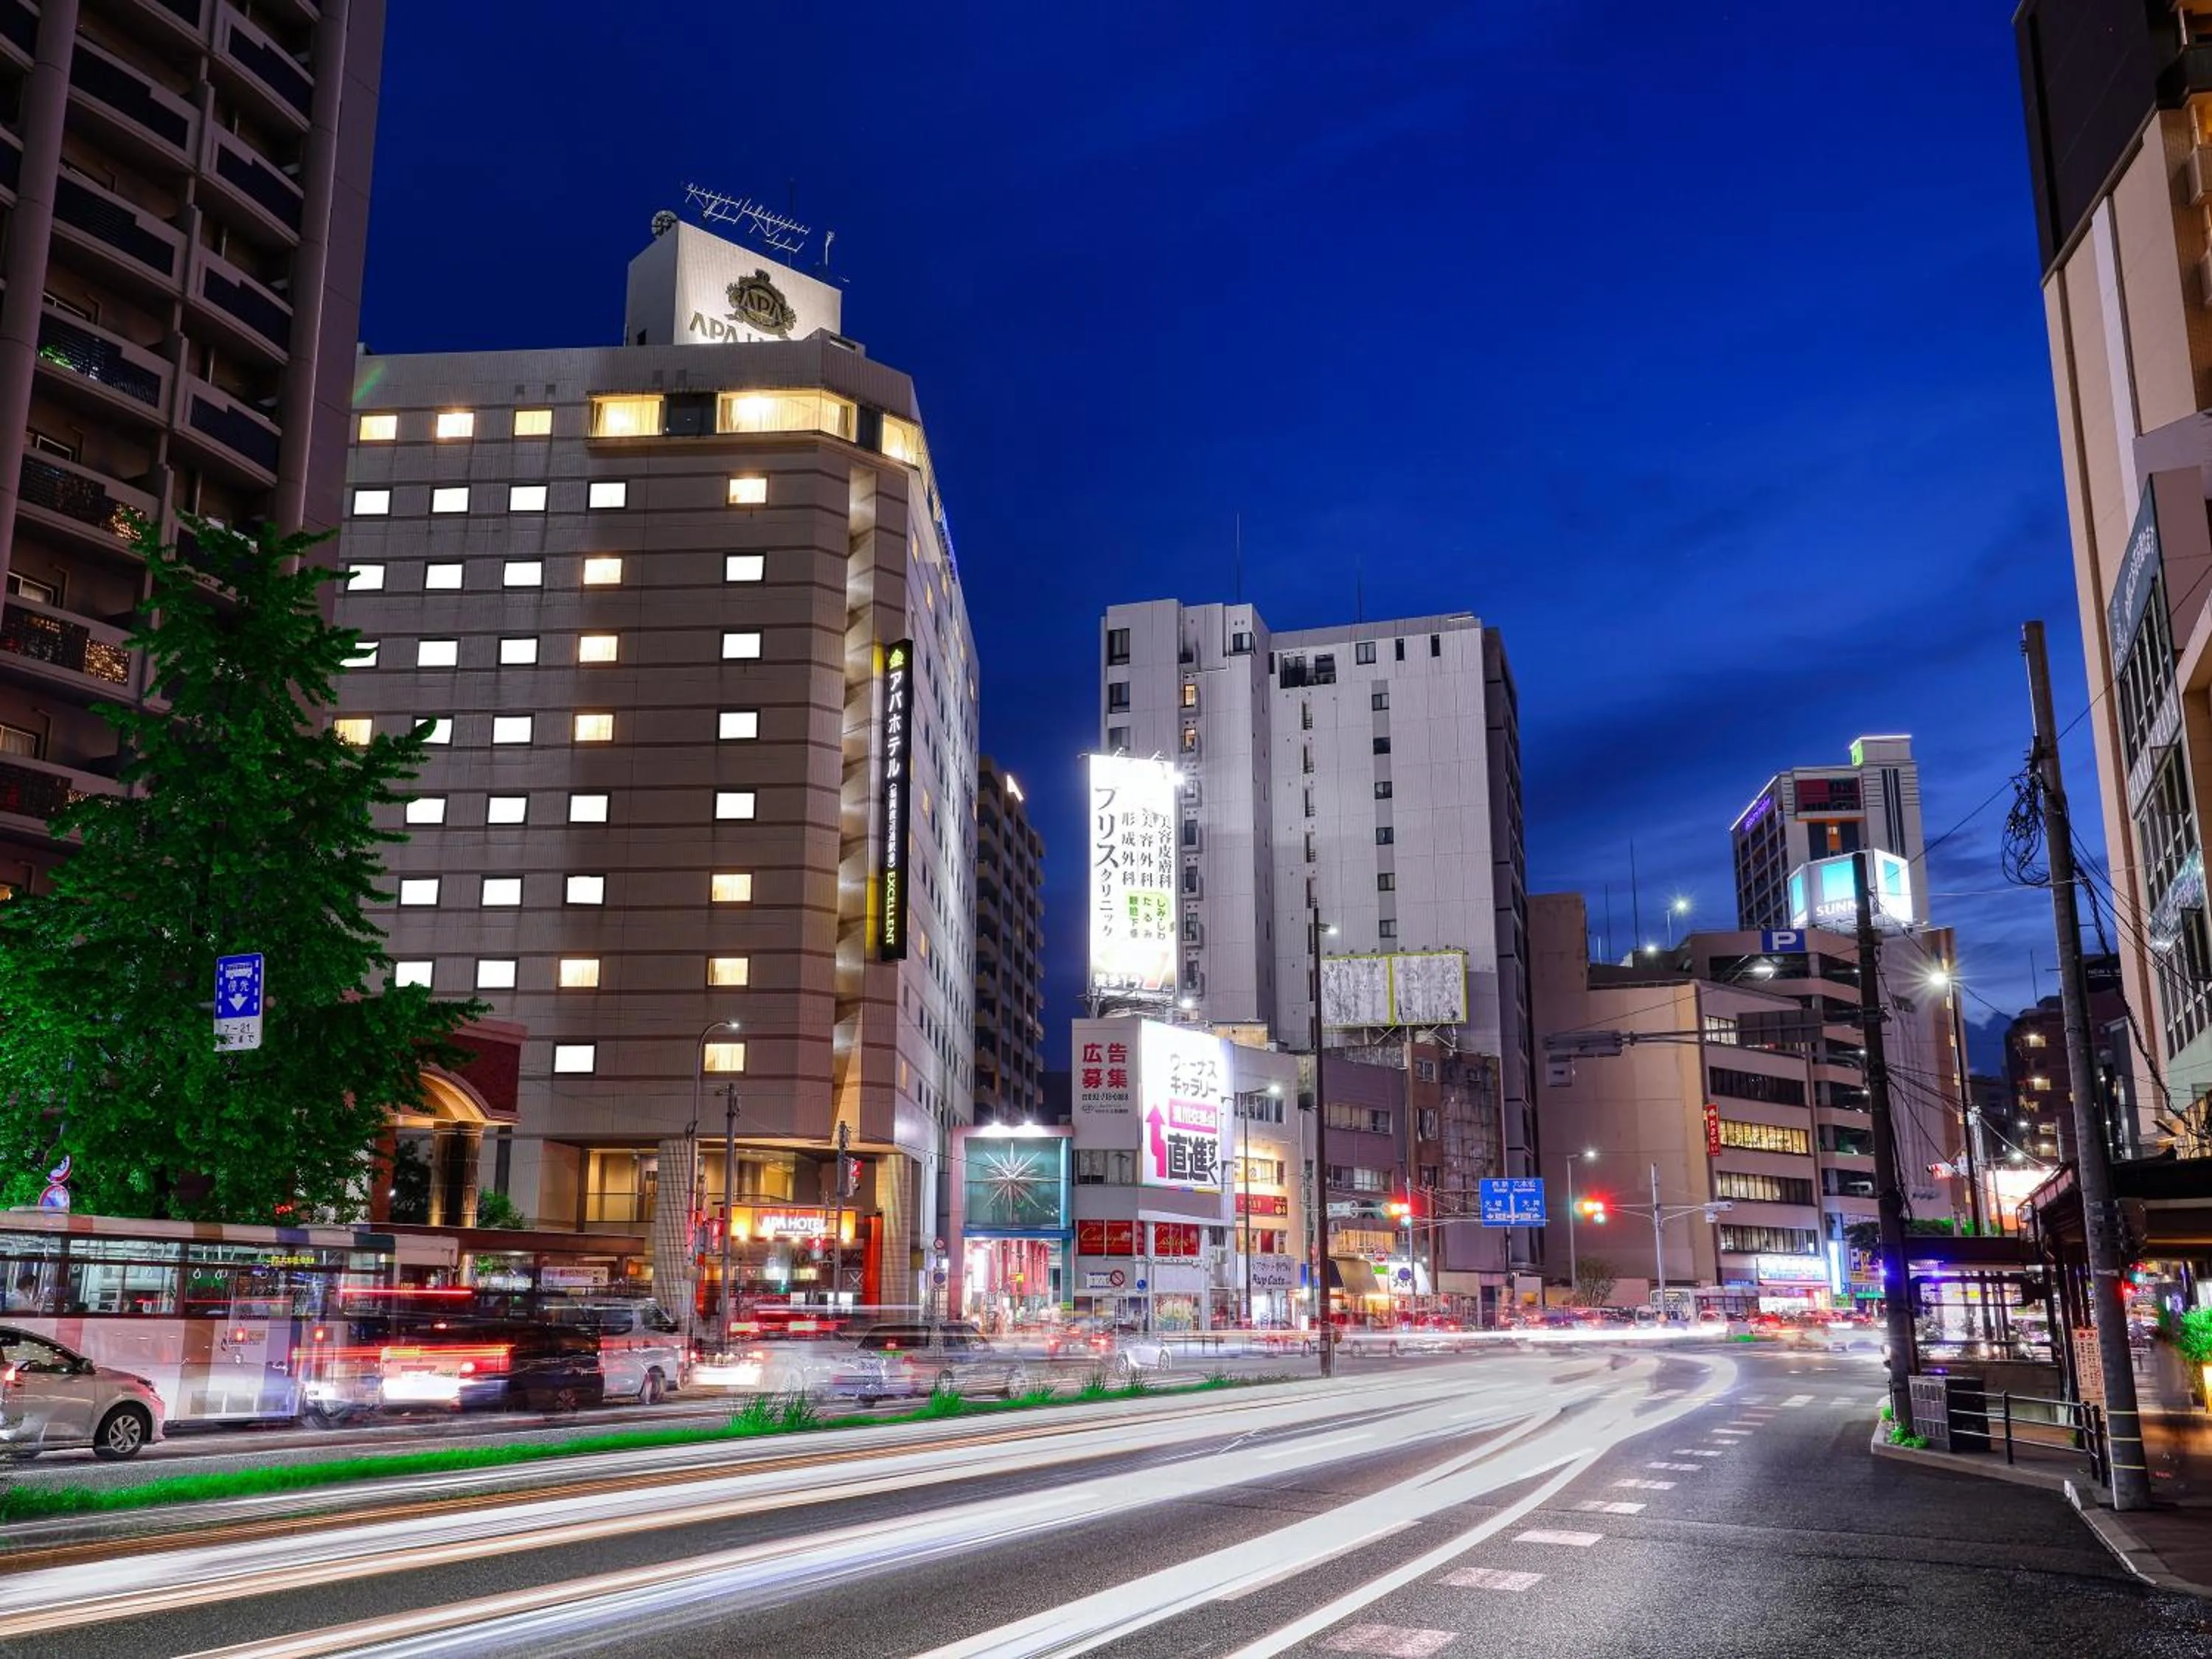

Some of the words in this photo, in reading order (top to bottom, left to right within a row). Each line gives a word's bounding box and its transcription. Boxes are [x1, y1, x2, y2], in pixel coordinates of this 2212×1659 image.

[1121, 812, 1136, 886] 形成外科
[886, 871, 897, 945] EXCELLENT
[1773, 931, 1797, 950] P
[228, 980, 250, 992] 優先
[1082, 1042, 1127, 1063] 広告
[1082, 1068, 1127, 1089] 募集
